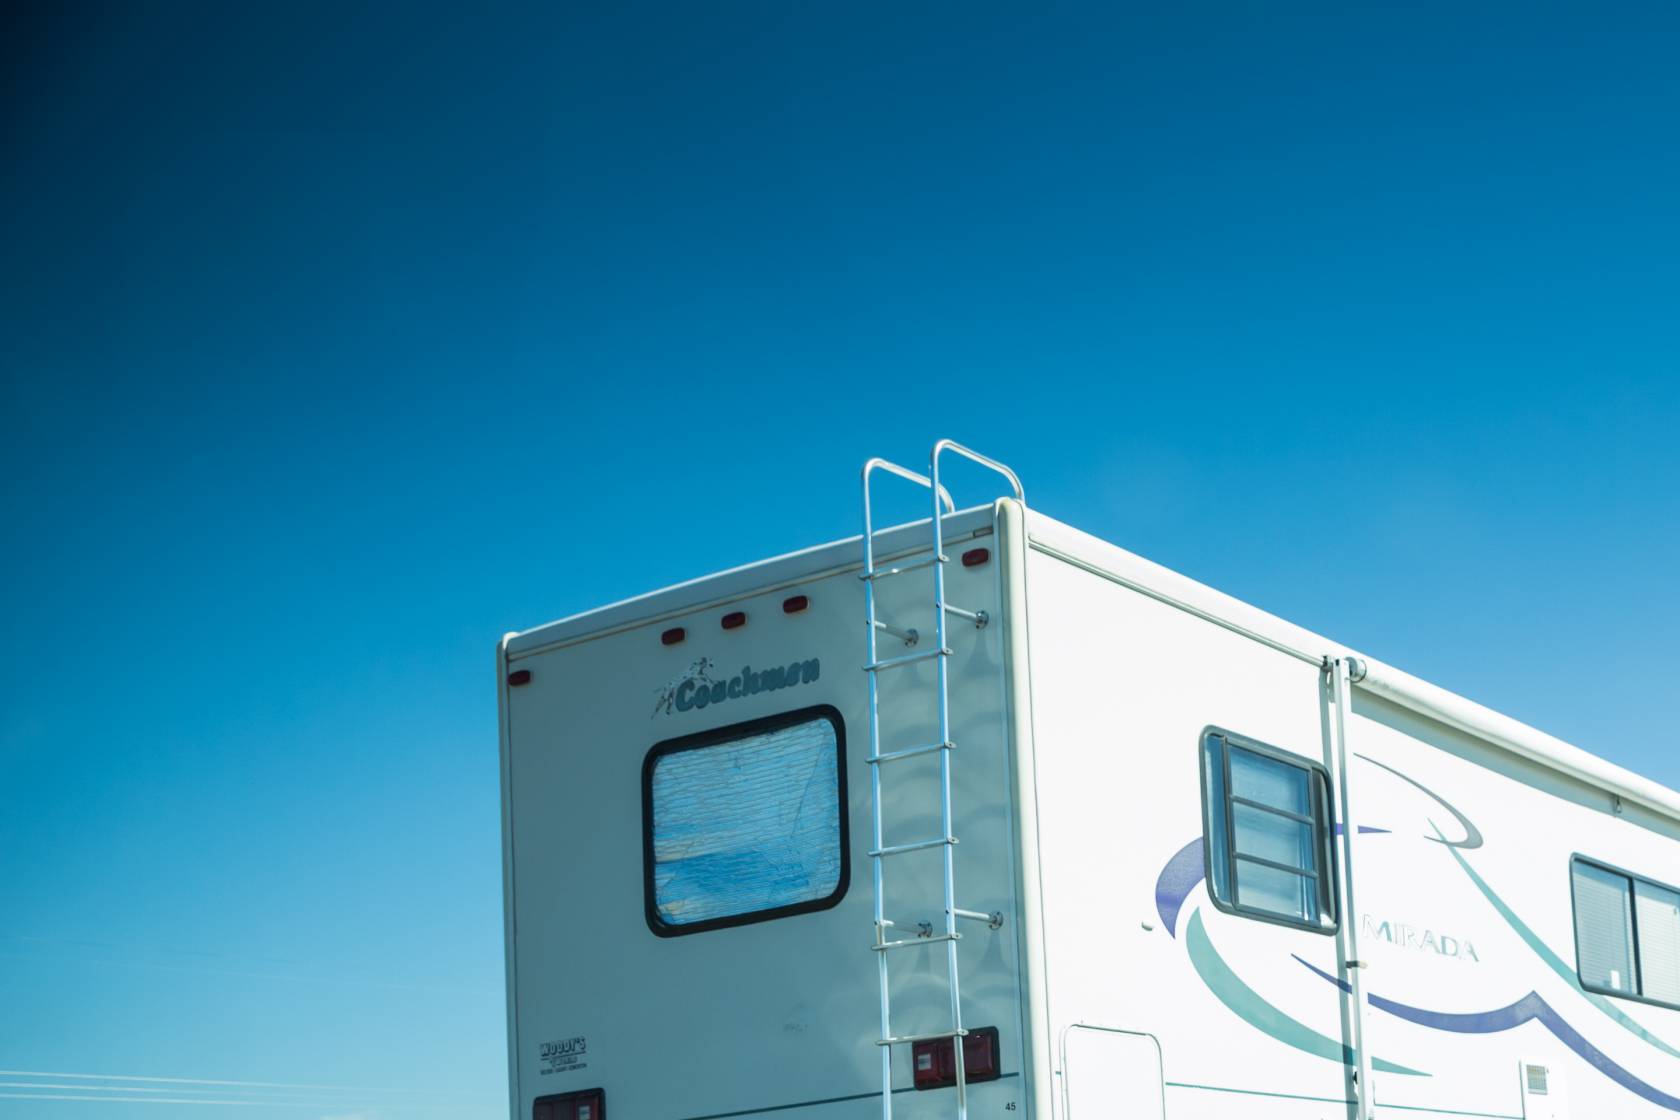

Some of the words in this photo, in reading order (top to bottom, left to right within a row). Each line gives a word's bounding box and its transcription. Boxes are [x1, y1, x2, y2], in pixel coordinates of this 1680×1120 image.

[675, 657, 820, 712] Coachmen
[1362, 913, 1480, 962] MIRADA
[1005, 1102, 1017, 1111] 45
